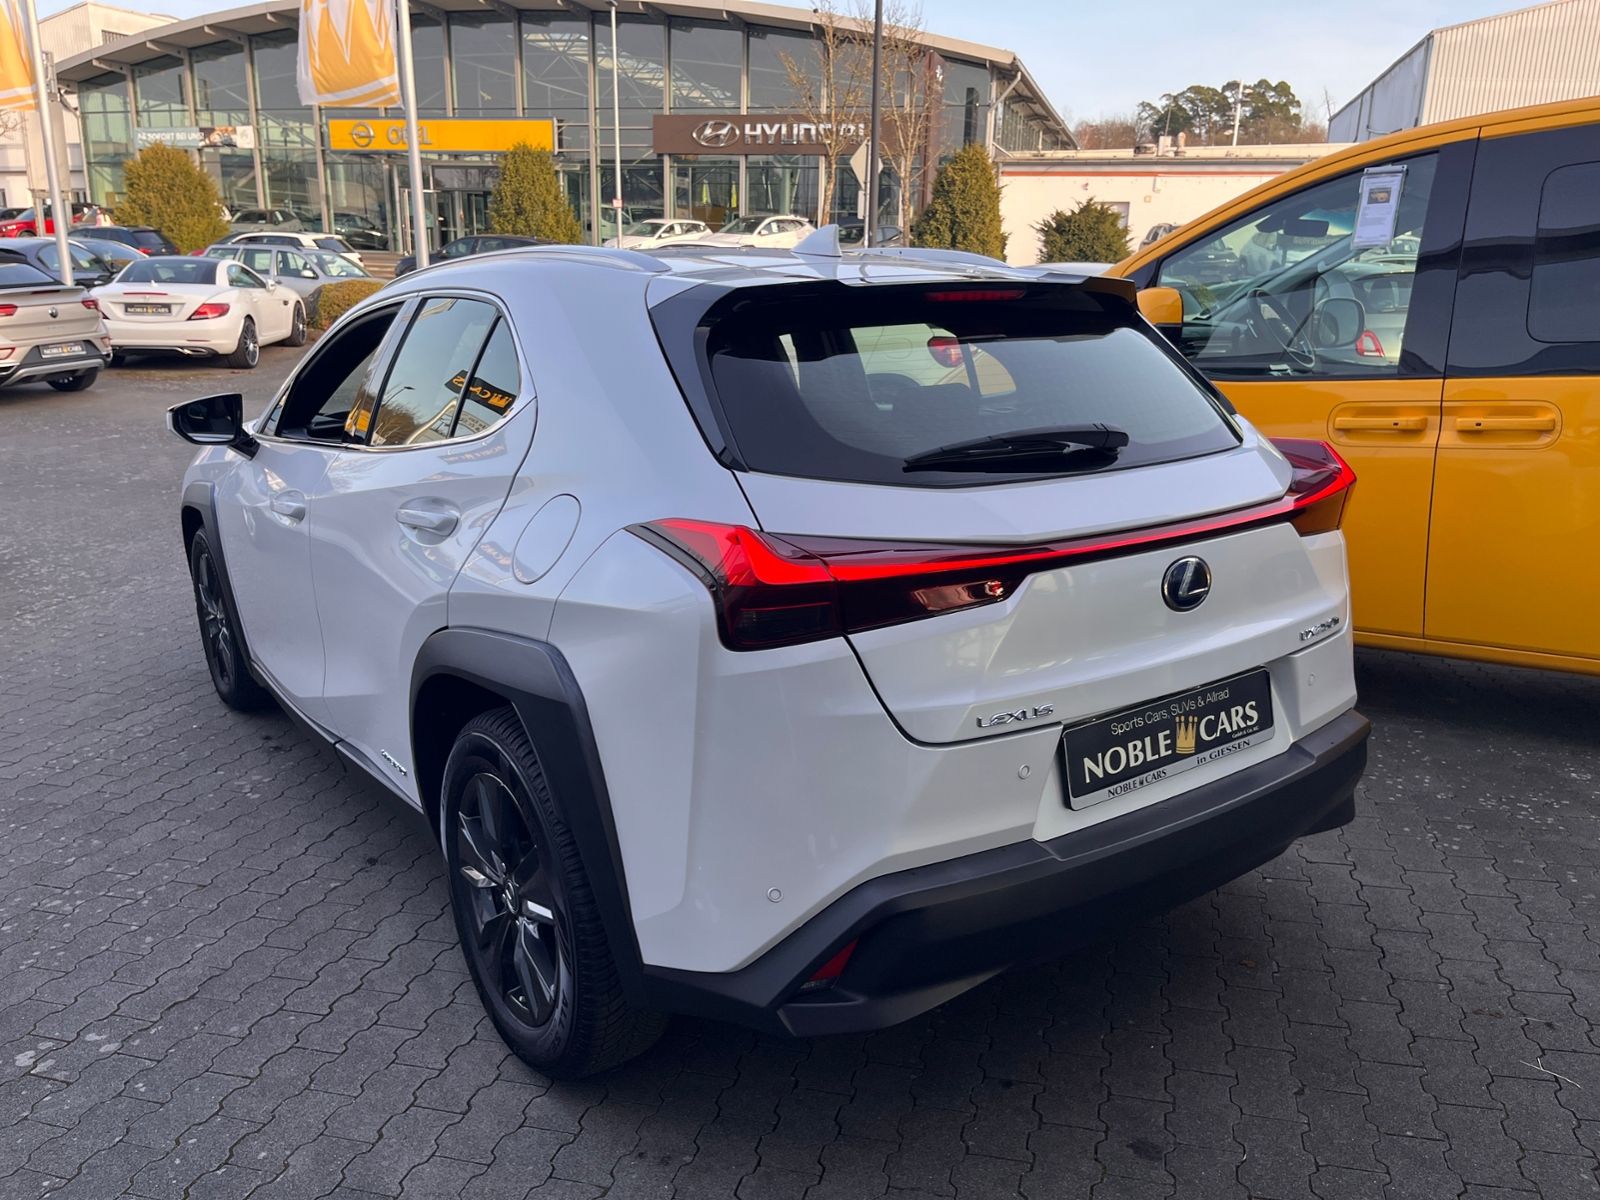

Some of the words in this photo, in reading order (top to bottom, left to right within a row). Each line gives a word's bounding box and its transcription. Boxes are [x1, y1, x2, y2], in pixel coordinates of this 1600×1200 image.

[387, 125, 432, 145] OL
[976, 703, 1054, 728] LEXUS
[1111, 716, 1144, 736] Sports
[1170, 699, 1196, 716] SUVs
[1197, 696, 1206, 708] &
[1206, 687, 1230, 704] Allrad
[1083, 730, 1172, 784] NOBLE
[1199, 701, 1259, 742] CARS
[1196, 754, 1207, 765] in
[1209, 739, 1251, 760] GIESSEN
[1107, 780, 1138, 798] NOBLE
[1145, 769, 1167, 784] CARS
